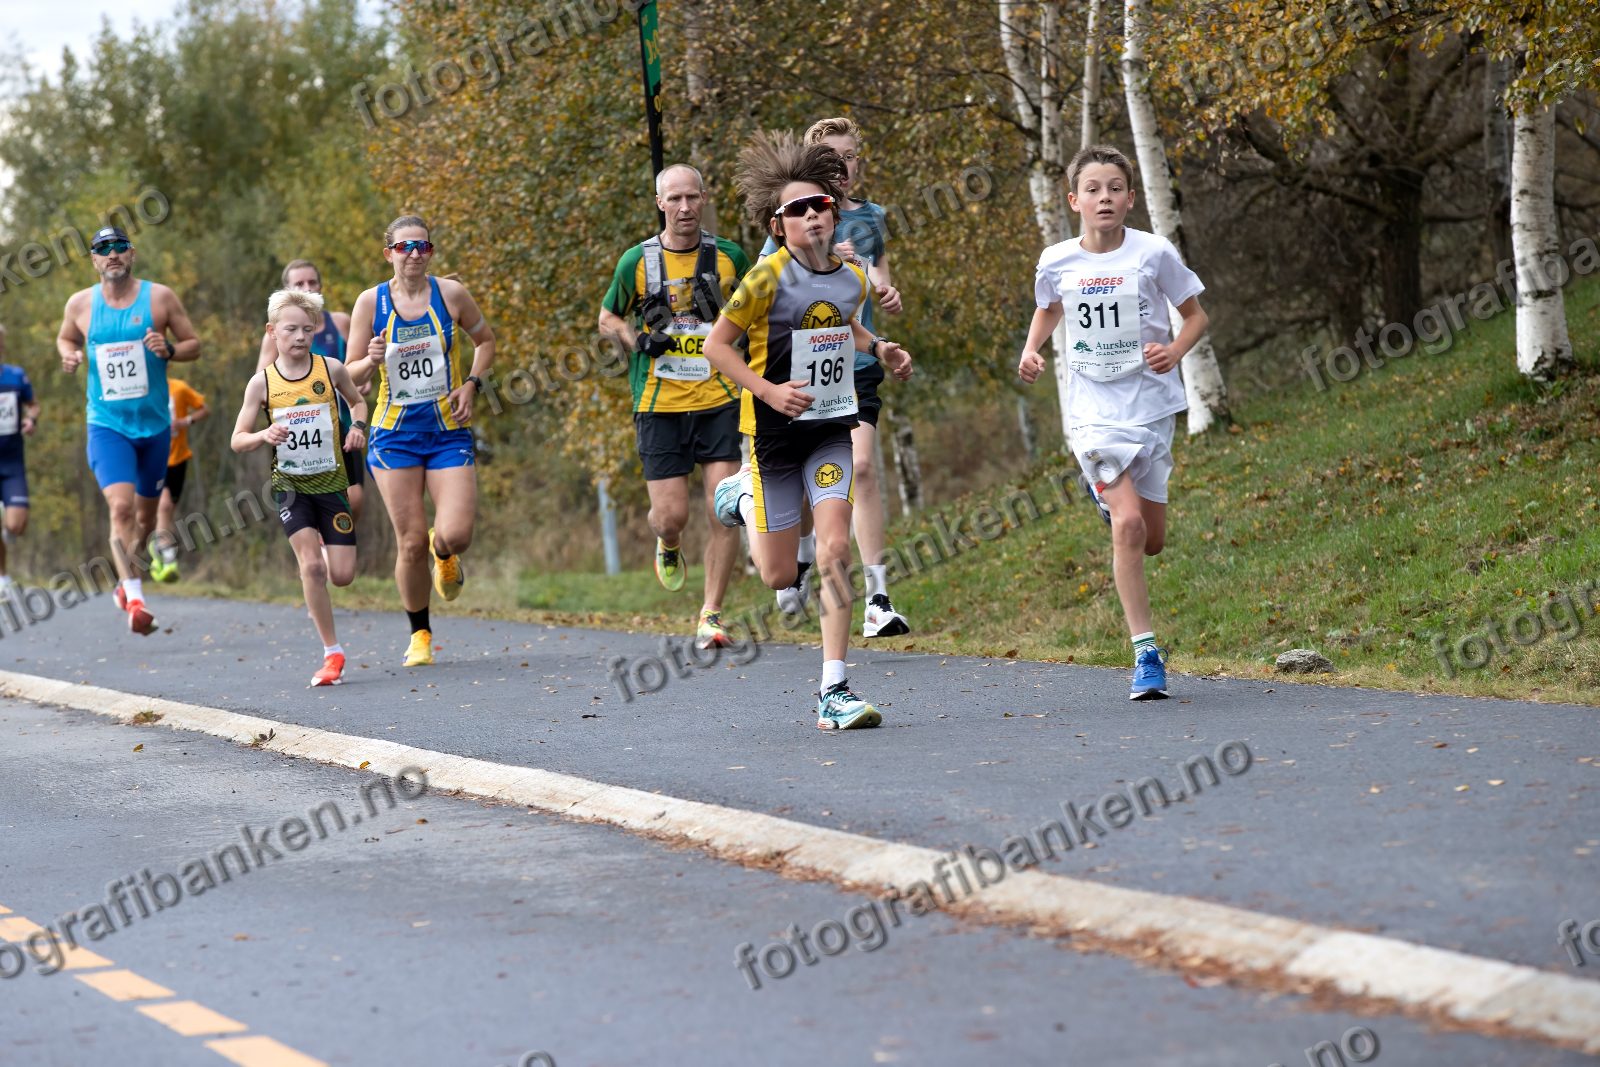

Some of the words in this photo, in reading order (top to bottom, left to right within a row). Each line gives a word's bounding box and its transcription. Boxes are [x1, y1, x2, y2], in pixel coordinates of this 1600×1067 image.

[1078, 276, 1124, 286] NORGES
[1081, 286, 1116, 295] LØPET
[1077, 301, 1120, 329] 311
[808, 332, 850, 345] NORGES
[397, 341, 431, 353] NORGES
[675, 337, 704, 355] ACE
[812, 342, 844, 353] LØPET
[1096, 339, 1138, 351] Aurskog
[401, 349, 426, 358] LØPET
[106, 360, 137, 380] 912
[398, 357, 434, 380] 840
[677, 365, 708, 374] Aurskog
[806, 356, 845, 387] 196
[819, 395, 854, 409] Aurskog
[286, 408, 320, 419] NORGES
[289, 416, 316, 425] LØPET
[287, 428, 323, 451] 344
[302, 456, 334, 468] Aurskog
